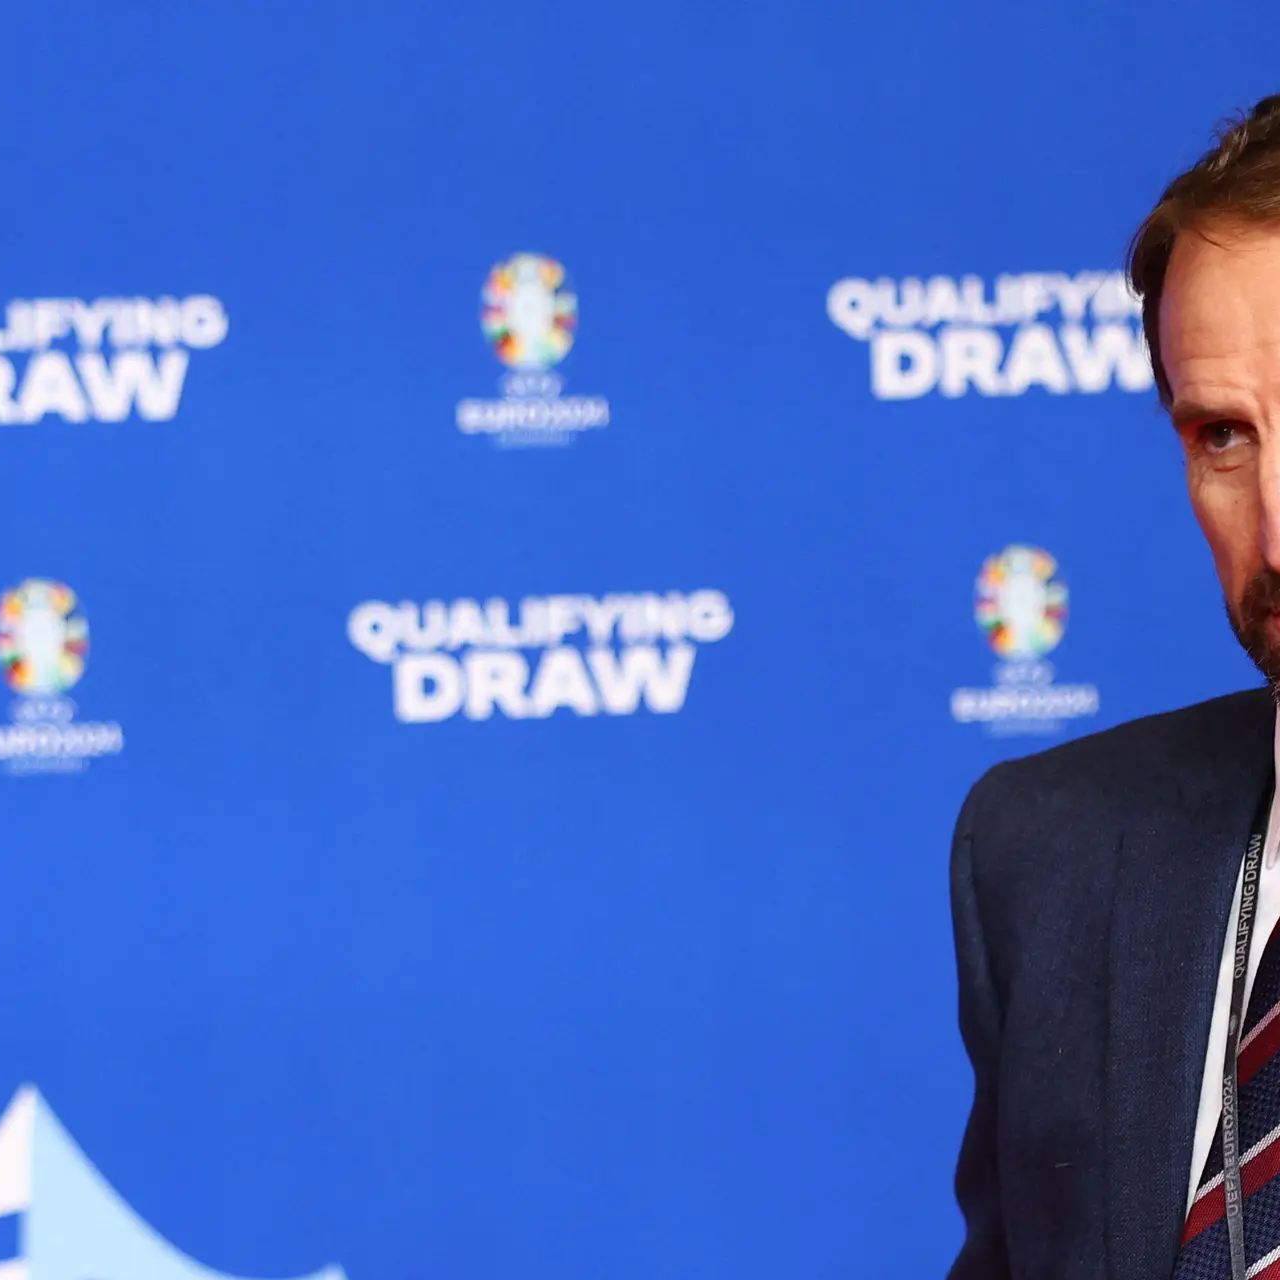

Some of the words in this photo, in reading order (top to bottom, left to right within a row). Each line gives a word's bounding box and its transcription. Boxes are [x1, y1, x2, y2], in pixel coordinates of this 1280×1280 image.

[827, 271, 1144, 341] QUALIFYI
[348, 590, 733, 662] QUALIFYING
[392, 646, 696, 722] DRAW
[1234, 884, 1256, 979] QUALIFYING
[1245, 834, 1262, 882] DRAW
